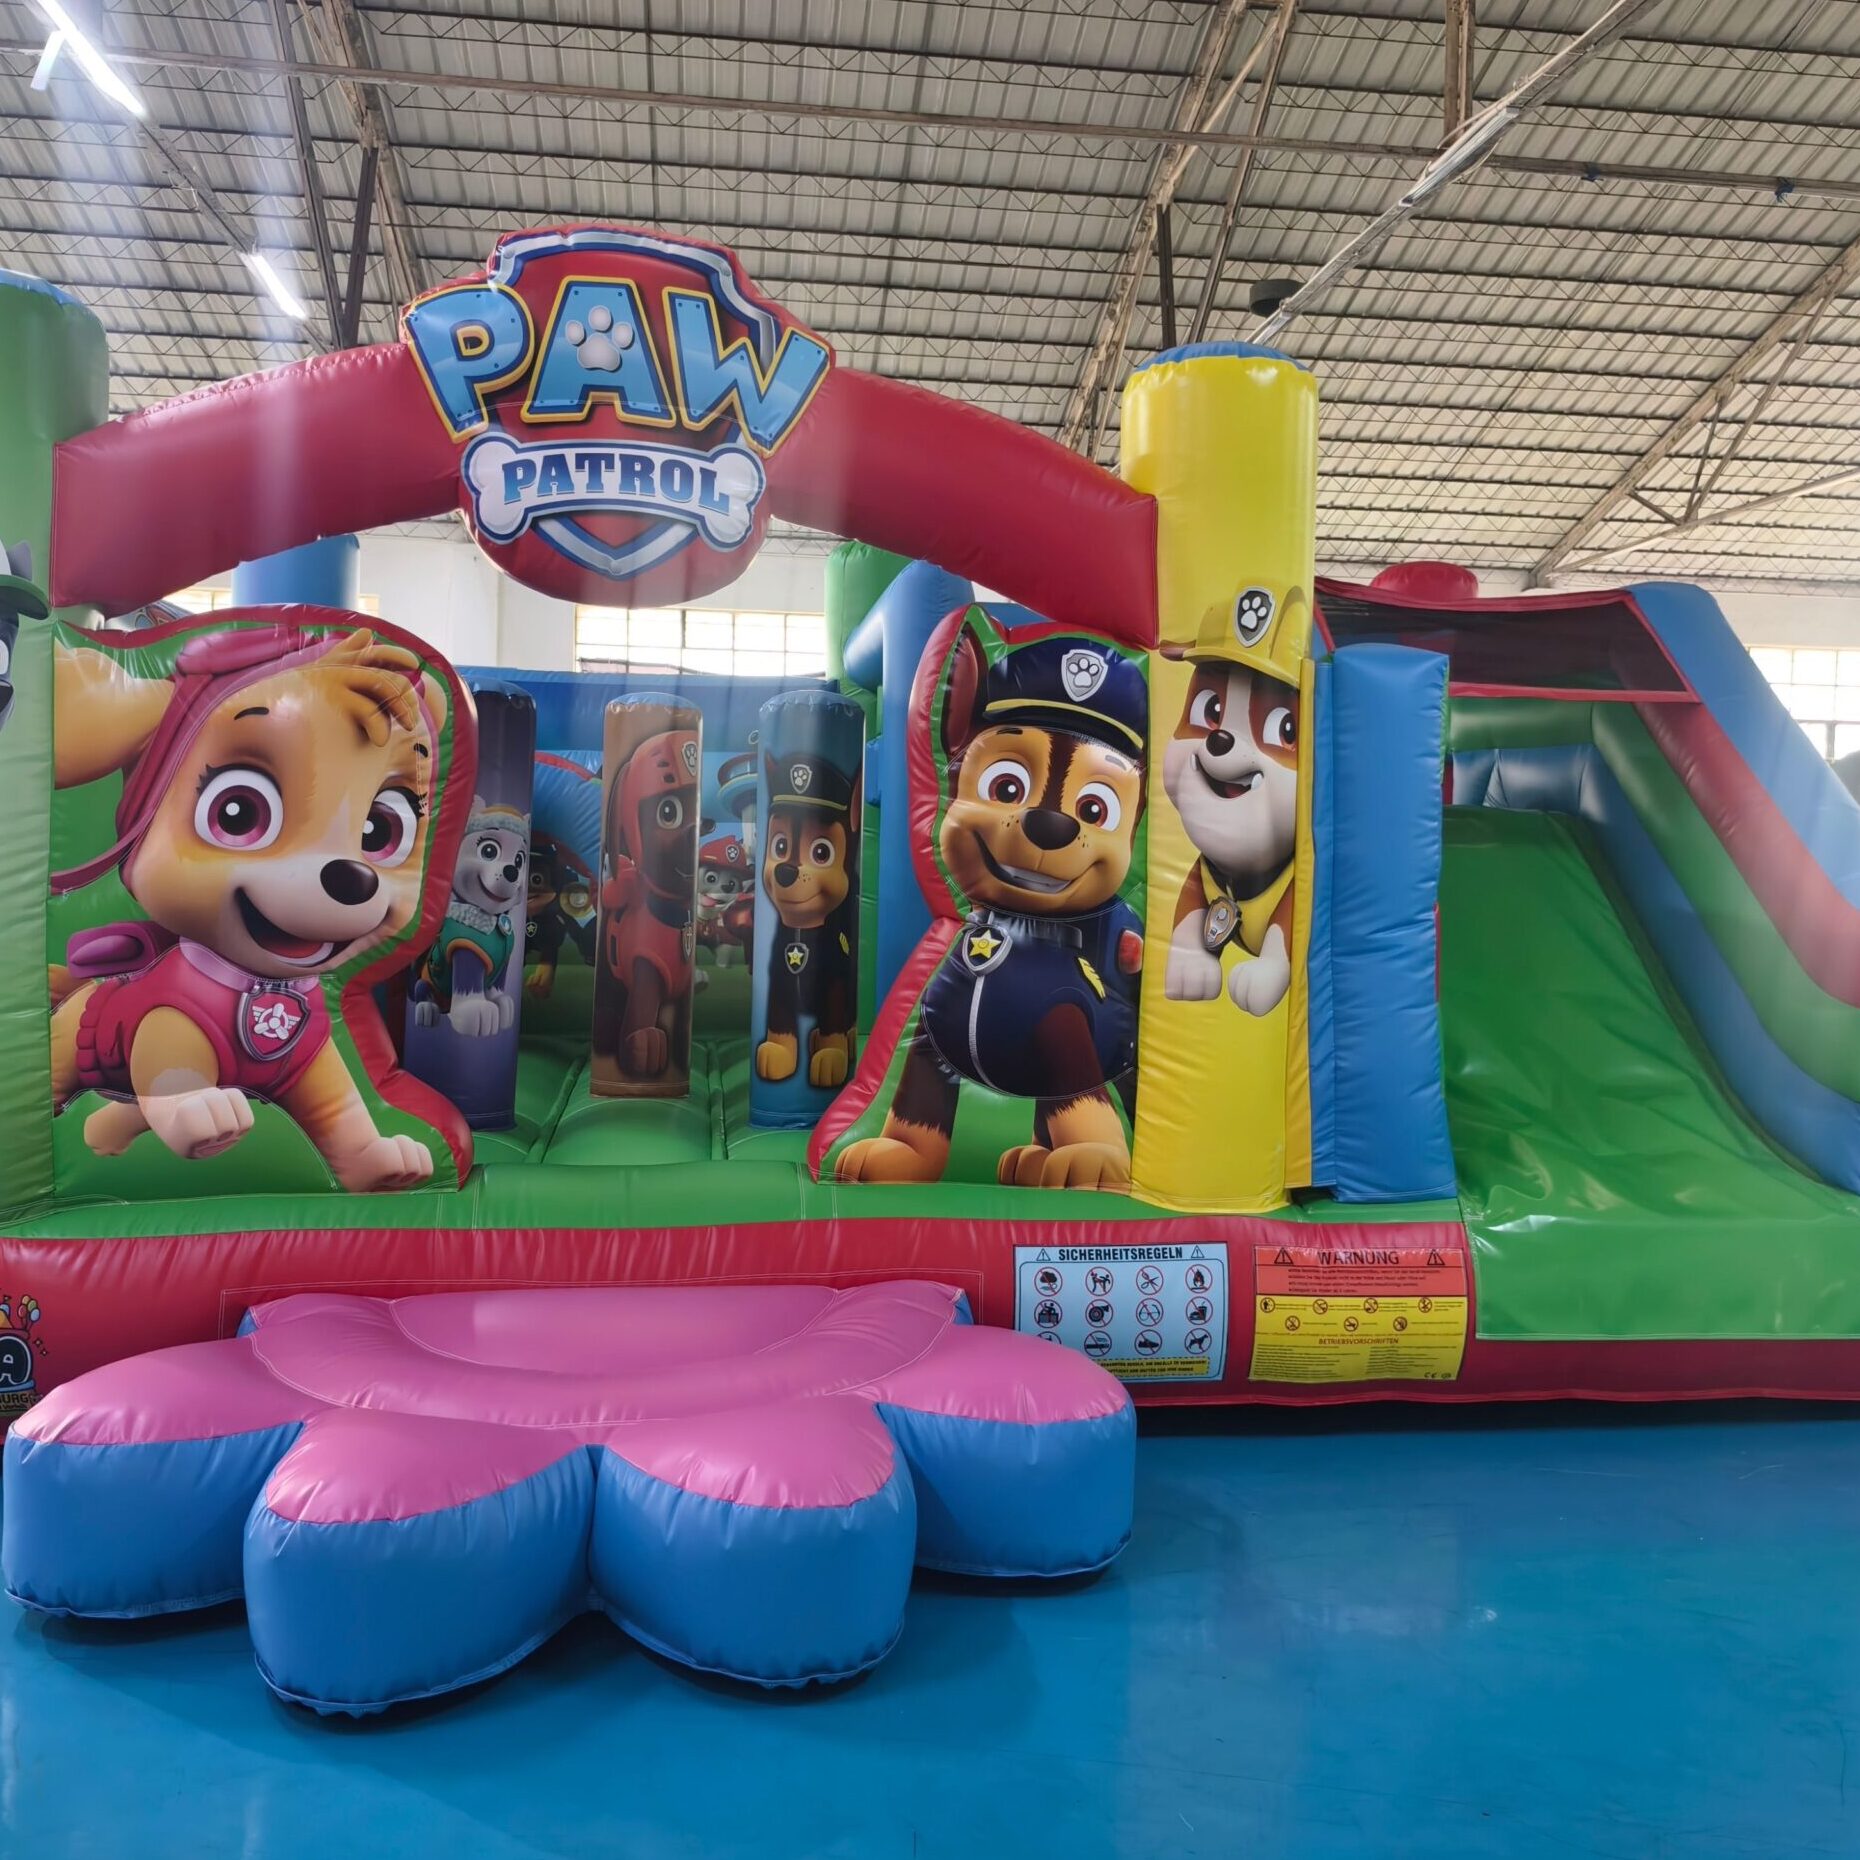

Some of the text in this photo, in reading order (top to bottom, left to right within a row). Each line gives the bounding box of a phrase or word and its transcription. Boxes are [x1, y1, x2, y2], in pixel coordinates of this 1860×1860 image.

[405, 275, 831, 459] PAW
[501, 451, 731, 516] PATROL
[1058, 1246, 1183, 1261] SICHERHEITSREGELN
[1318, 1250, 1400, 1265] WARNUNG
